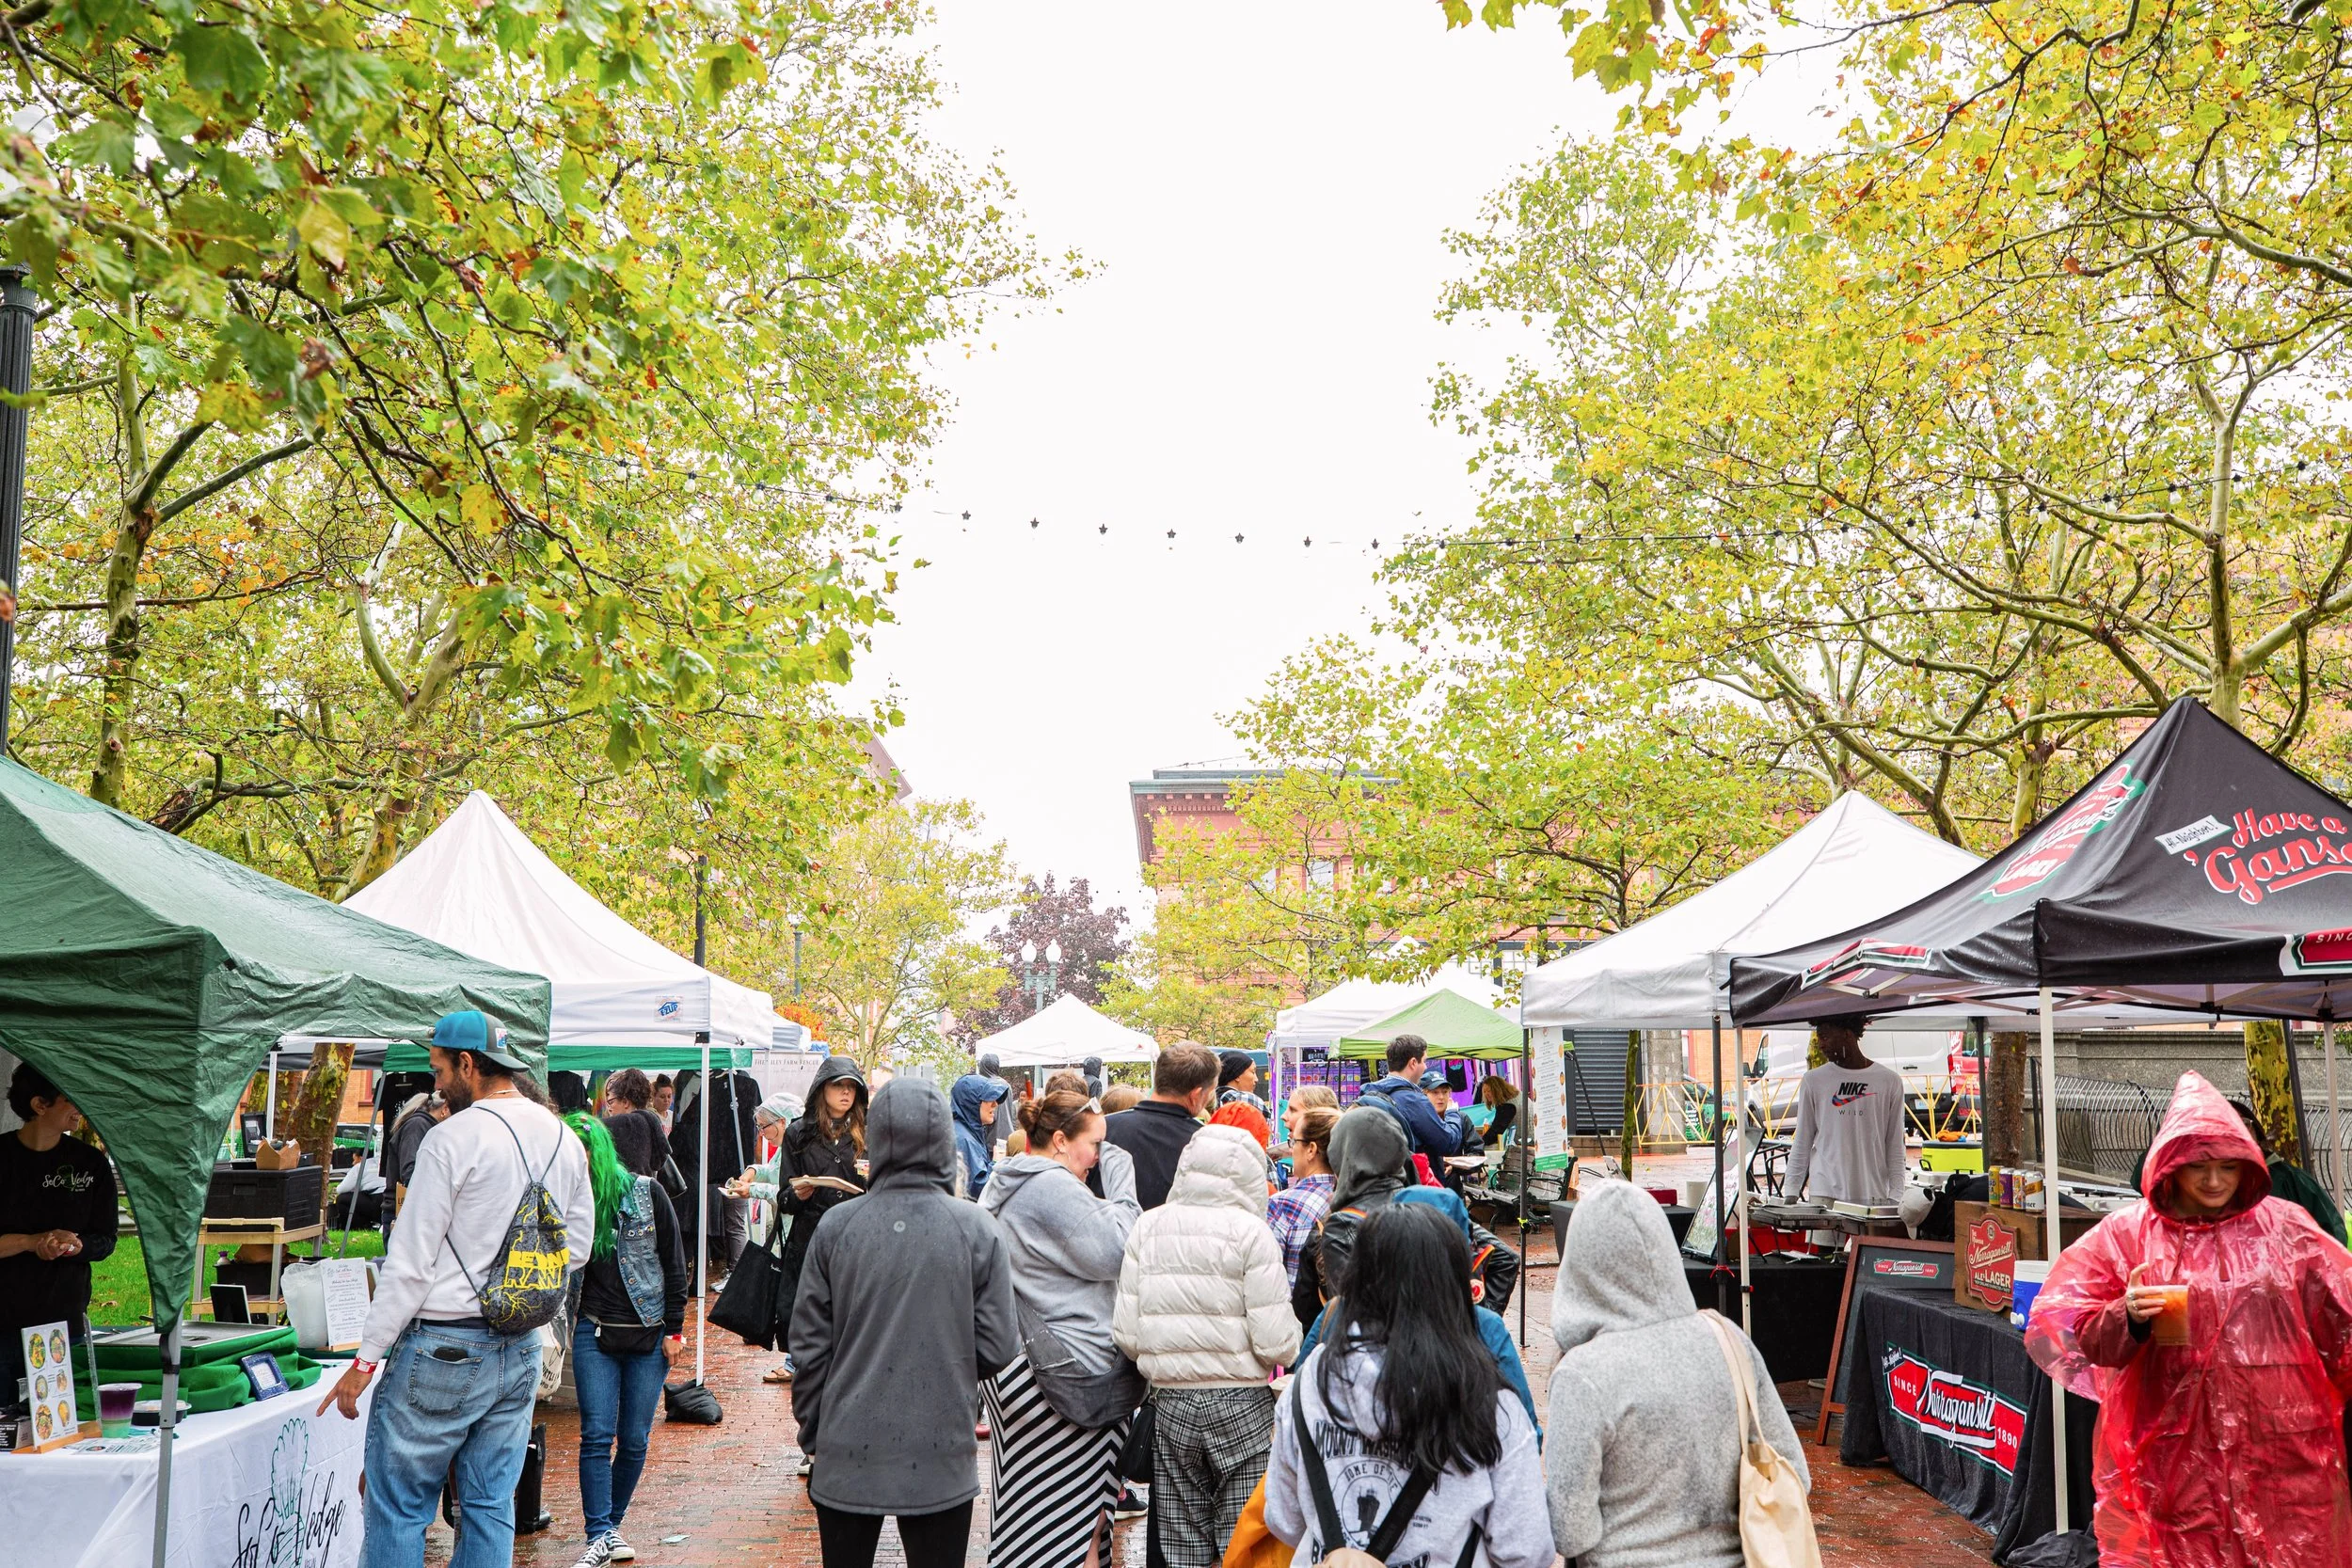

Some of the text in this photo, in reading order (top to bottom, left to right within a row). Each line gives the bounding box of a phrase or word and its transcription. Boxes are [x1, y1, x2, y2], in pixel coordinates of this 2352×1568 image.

[2233, 807, 2348, 847] Have a
[1837, 1082, 1868, 1095] NIKE
[1969, 1241, 2011, 1267] Narragansett
[504, 1266, 563, 1291] RAW
[1985, 1270, 2011, 1289] LAGER
[1894, 1369, 2018, 1449] SINCE Narragansett 1890
[1314, 1418, 1359, 1459] MOUNT
[1344, 1464, 1368, 1482] HOME
[1374, 1461, 1387, 1475] OF
[294, 1470, 346, 1568] Vedge
